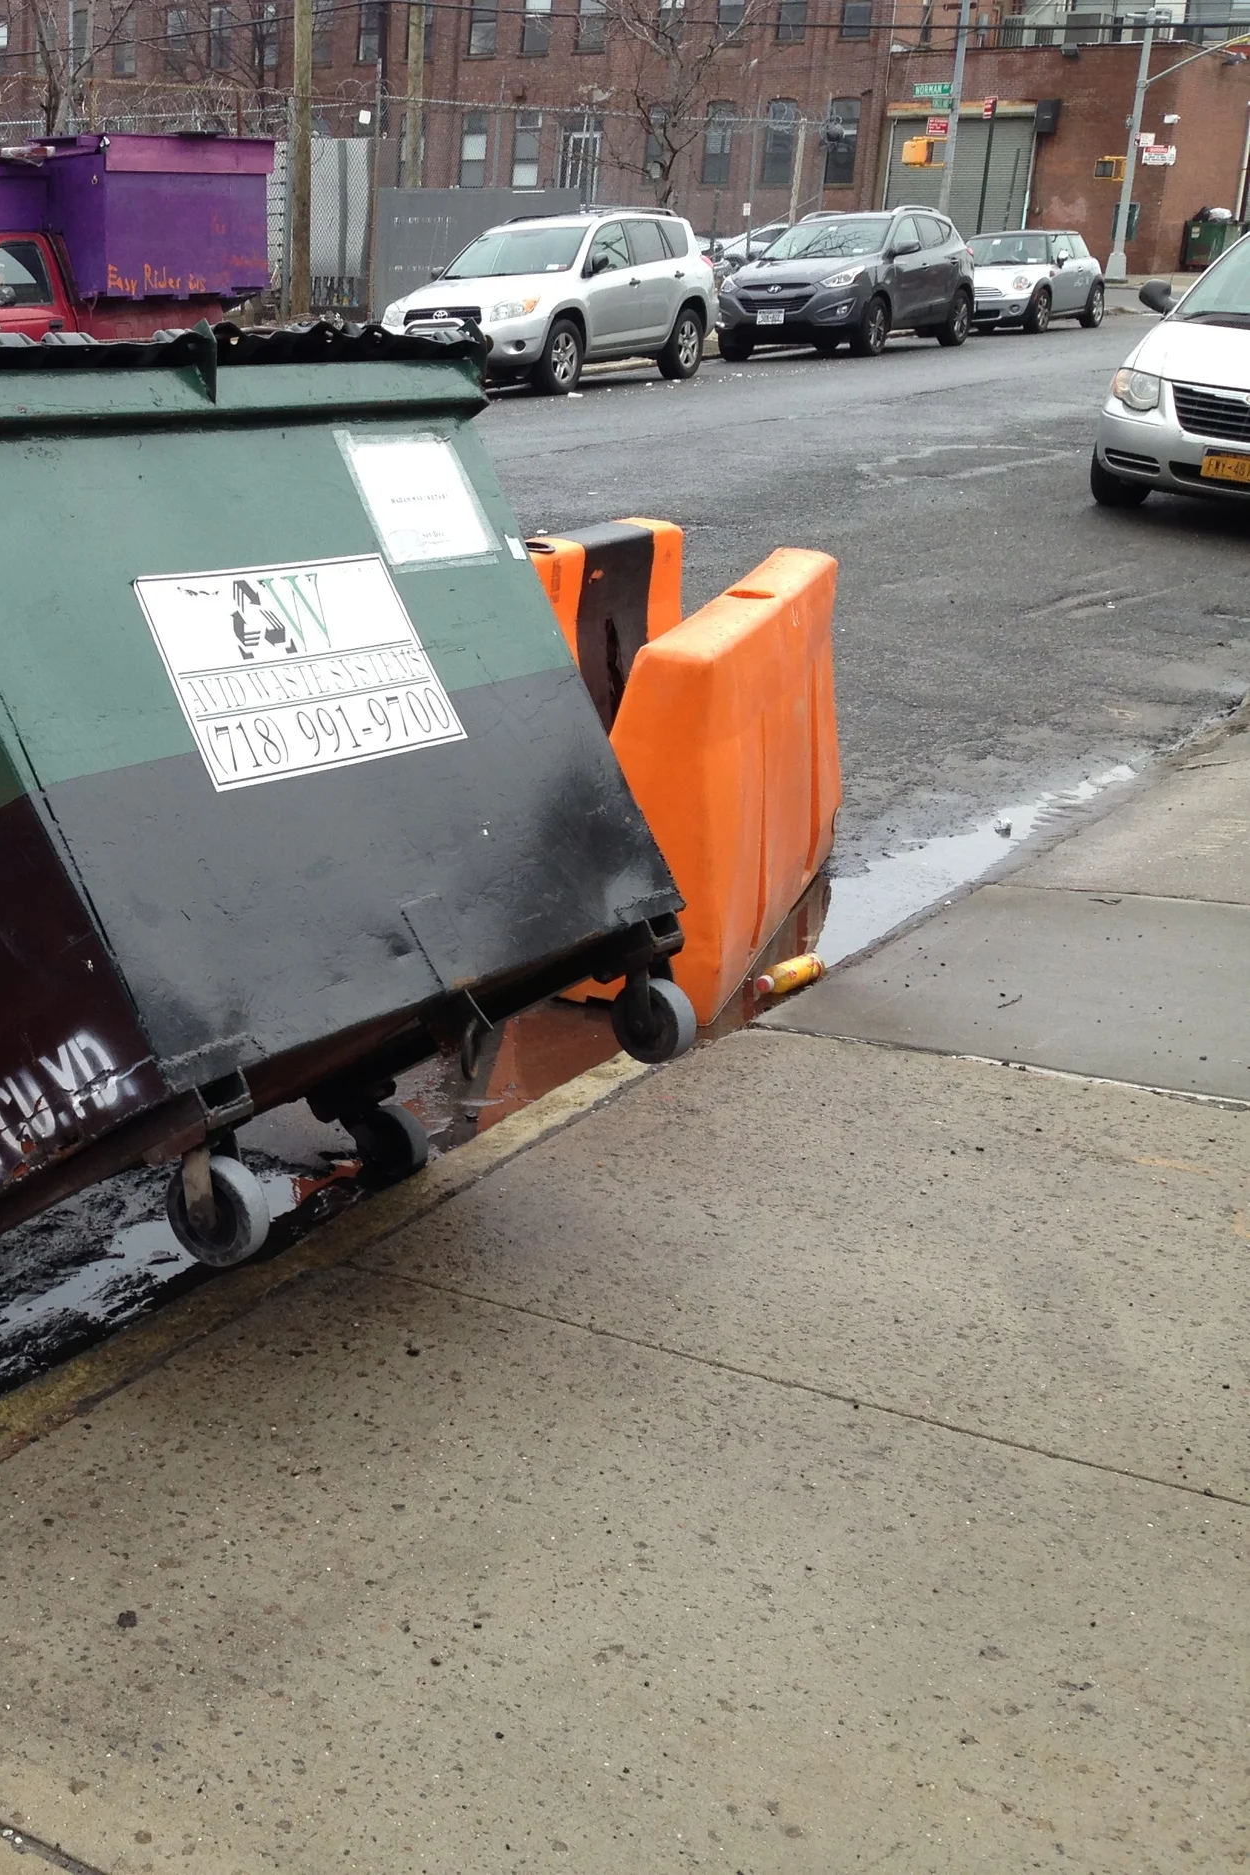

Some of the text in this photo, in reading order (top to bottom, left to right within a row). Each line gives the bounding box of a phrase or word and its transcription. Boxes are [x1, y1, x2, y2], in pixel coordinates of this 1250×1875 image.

[915, 84, 942, 95] NORMAN
[108, 263, 138, 295] Easy
[144, 263, 183, 291] Rider
[187, 648, 426, 714] AVID WASTE SYSTEMS
[206, 687, 450, 775] (718) 991-9700
